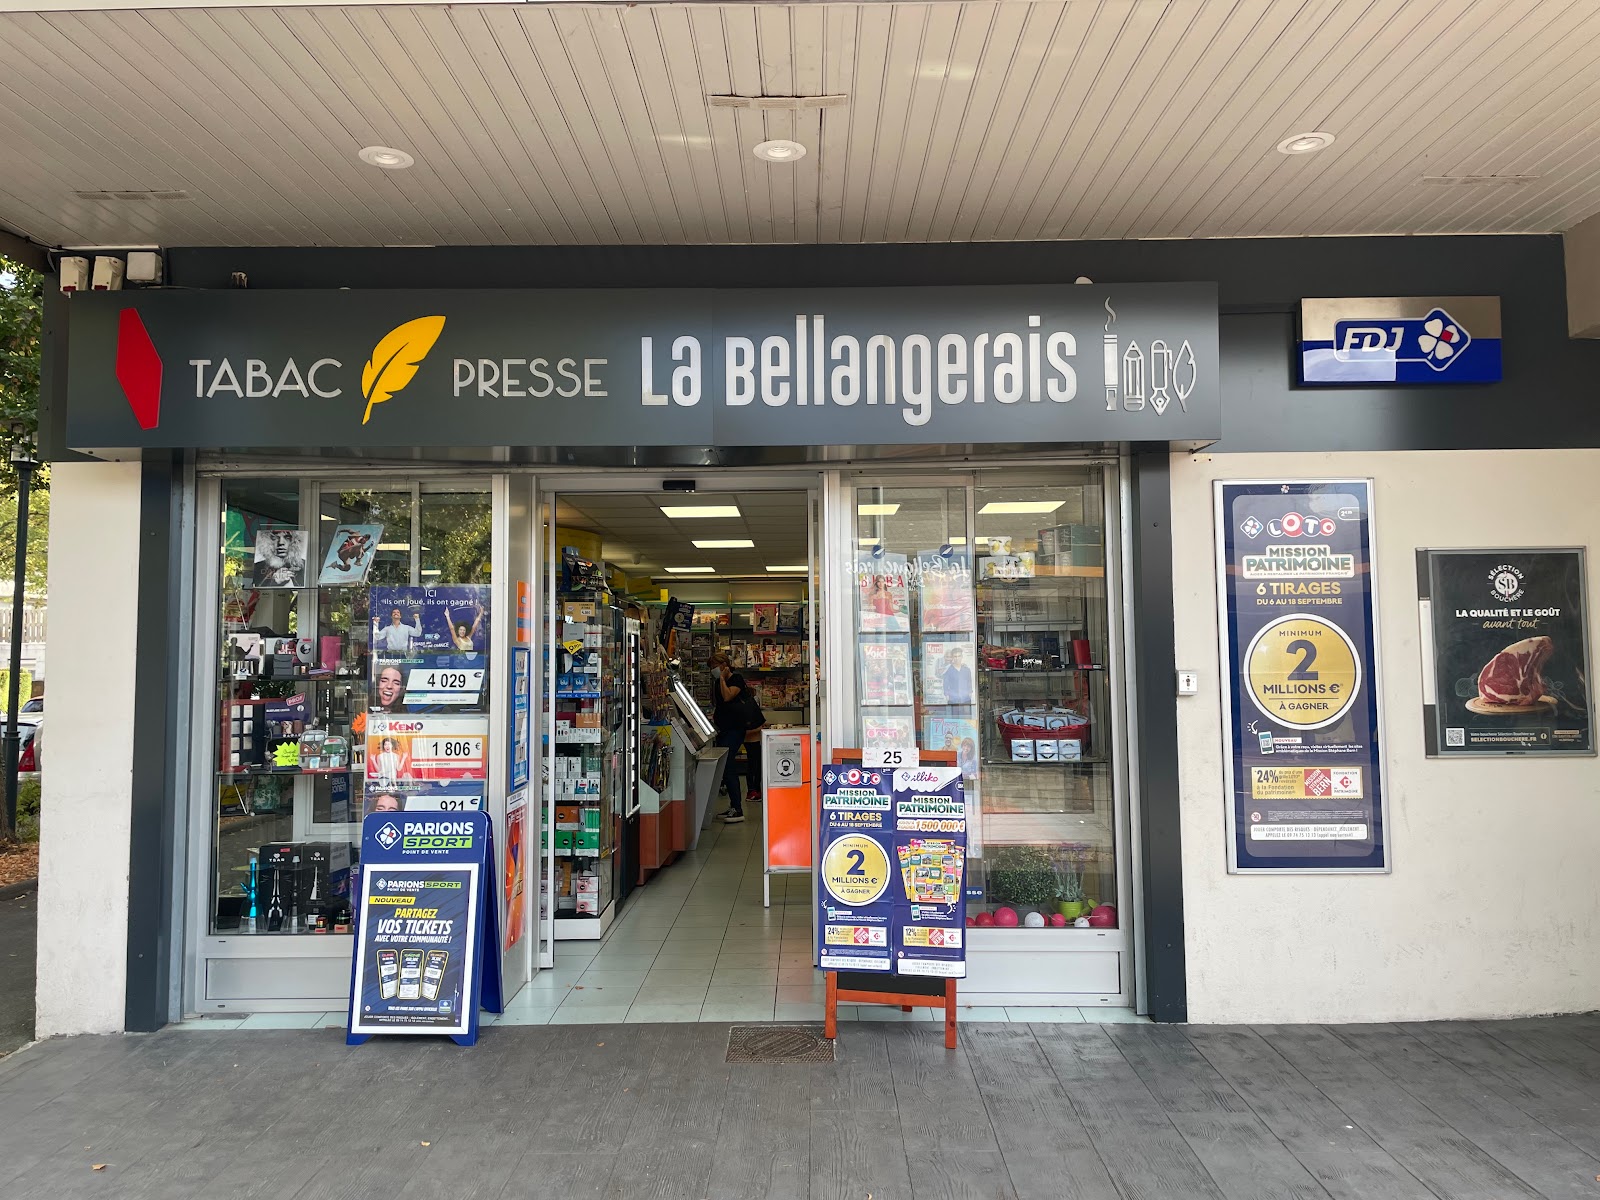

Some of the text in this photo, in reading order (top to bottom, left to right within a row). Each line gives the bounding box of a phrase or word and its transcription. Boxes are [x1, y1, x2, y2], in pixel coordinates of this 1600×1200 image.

[1342, 327, 1404, 353] FDJ
[727, 314, 1077, 426] Bellangerais
[189, 358, 342, 398] TABAC
[454, 358, 608, 397] PRESSE
[1267, 512, 1336, 537] LOTO
[1269, 547, 1327, 557] MISSION
[1246, 557, 1351, 571] PATRIMOINE
[1488, 564, 1524, 581] SÉLECTION
[1256, 582, 1341, 595] 6 TIRAGES
[1498, 578, 1515, 590] SB
[425, 589, 437, 597] ICI
[1490, 588, 1525, 603] BOUCHÈRE
[1456, 609, 1468, 617] LA
[1470, 608, 1509, 617] QUALITÉ
[1534, 607, 1561, 617] GOÛT
[1482, 618, 1540, 629] avant tout
[865, 646, 887, 658] Voici
[1286, 639, 1319, 680] 2
[427, 674, 436, 687] 4
[441, 673, 466, 687] 029
[1263, 684, 1326, 694] MILLIONS
[1279, 701, 1286, 710] À
[389, 721, 424, 731] KENO
[432, 742, 438, 756] 1
[445, 742, 470, 756] 806
[883, 751, 903, 764] 25
[838, 768, 881, 785] LOTO
[911, 772, 939, 782] illiko
[1313, 777, 1332, 796] BERN
[839, 789, 875, 797] MISSION
[440, 800, 464, 811] 921
[825, 796, 889, 806] PATRIMOINE
[899, 803, 964, 814] PATRIMOINE
[829, 812, 882, 822] 6 TIRAGES
[404, 822, 474, 835] PARIONS
[921, 820, 939, 830] 500
[941, 821, 958, 831] 000
[959, 822, 964, 830] €
[405, 837, 471, 847] SPORT
[846, 850, 866, 876] 2
[832, 876, 869, 884] MILLIONS
[394, 908, 438, 919] PARTAGEZ
[377, 919, 453, 935] VOS TICKETS
[391, 935, 409, 943] VOTRE
[409, 935, 448, 943] COMMUNAUTÉ
